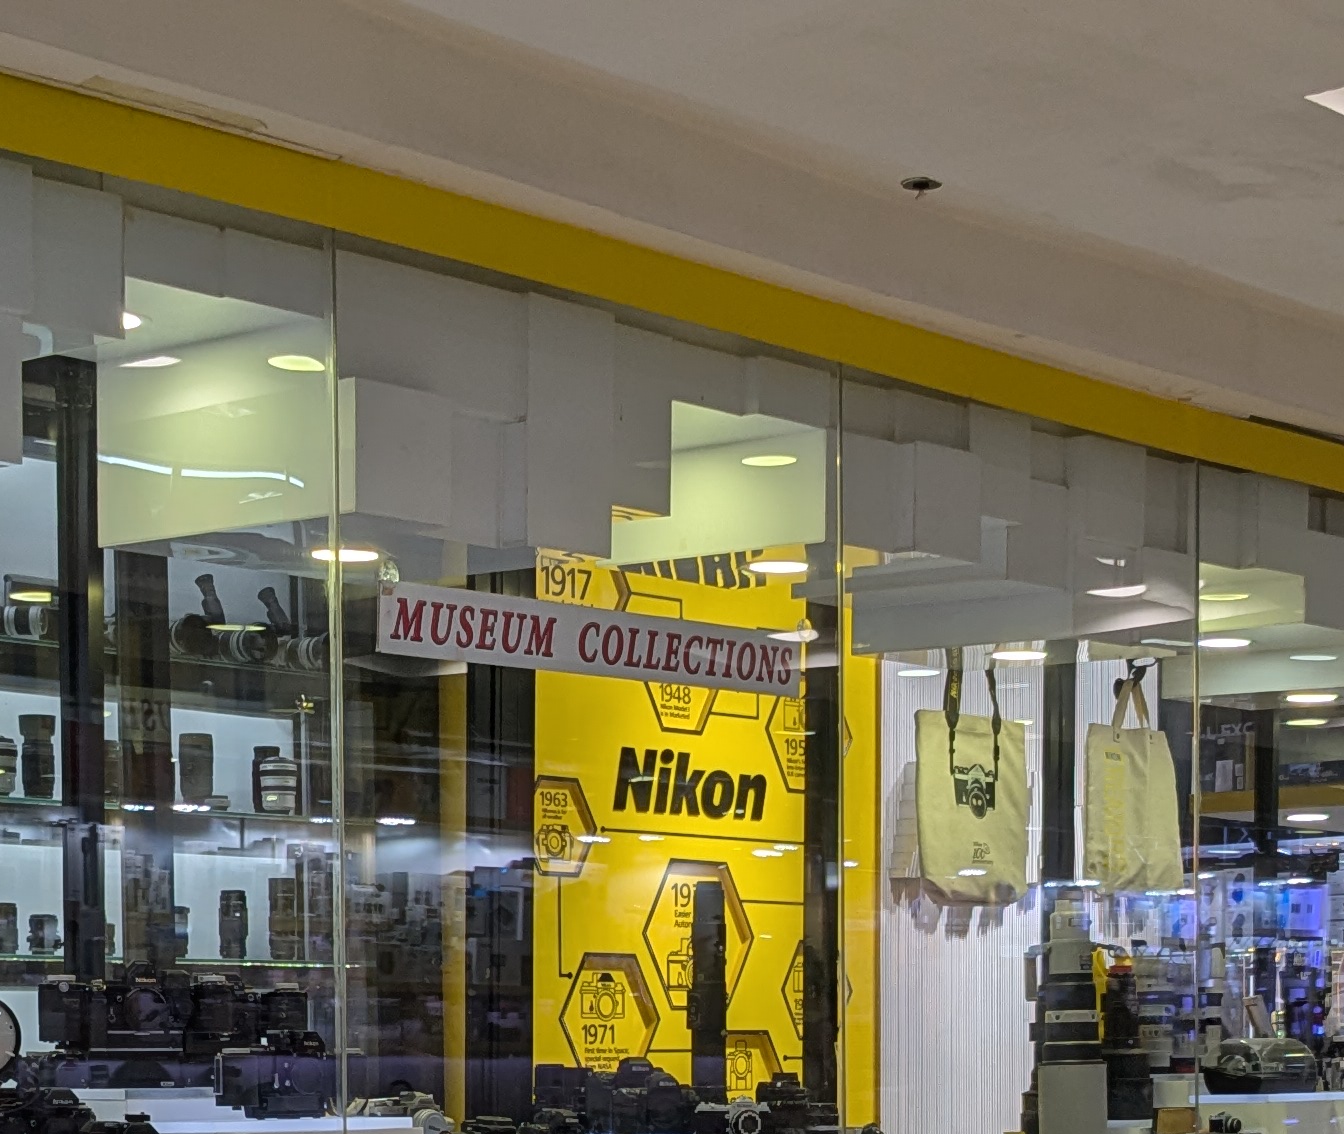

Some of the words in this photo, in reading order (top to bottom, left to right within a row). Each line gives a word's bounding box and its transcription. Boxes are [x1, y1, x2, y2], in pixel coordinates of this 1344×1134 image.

[540, 565, 592, 602] 1917
[389, 597, 559, 658] MUSEUM
[577, 621, 794, 686] COLLECTIONS
[659, 683, 692, 705] 1948
[784, 738, 806, 757] 195
[613, 746, 768, 822] Nikon
[540, 791, 568, 808] 1963
[581, 1024, 616, 1045] 1971
